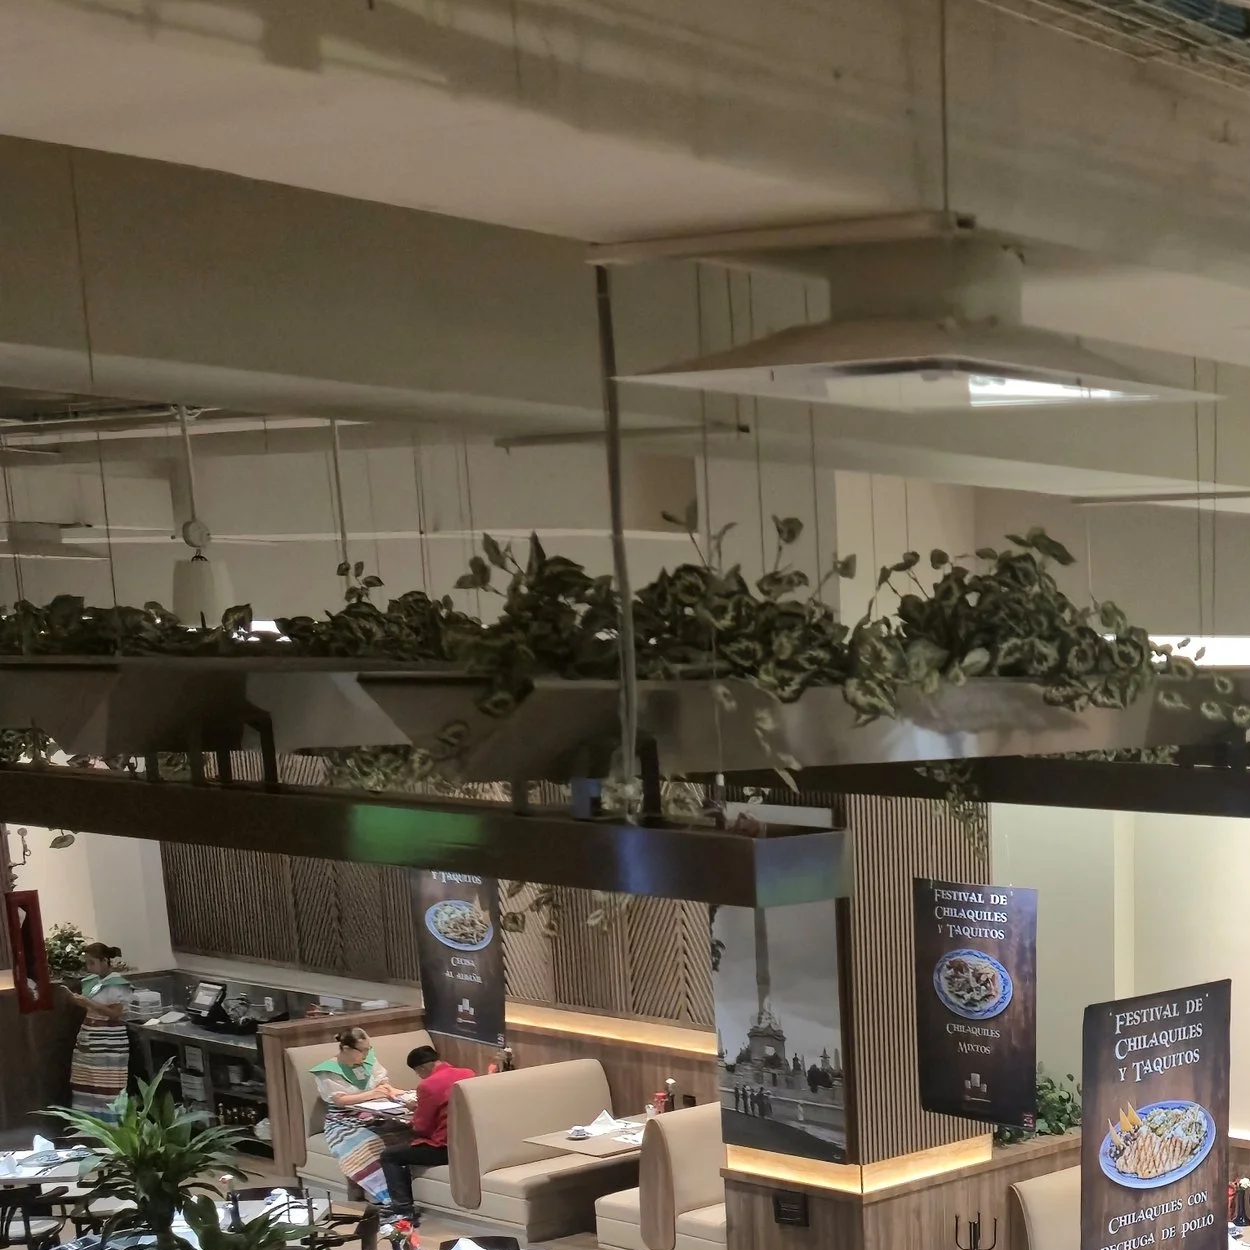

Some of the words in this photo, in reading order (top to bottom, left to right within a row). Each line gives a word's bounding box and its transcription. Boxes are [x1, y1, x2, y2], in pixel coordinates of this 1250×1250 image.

[934, 888, 984, 904] FESTIVAL
[990, 893, 1008, 906] DE
[934, 905, 1008, 923] CHILAQUILES
[937, 924, 943, 935] Y
[947, 923, 1005, 940] TAQUITOS
[1115, 1003, 1180, 1034] FESTIVAL
[1186, 998, 1203, 1014] DE
[946, 1022, 1001, 1039] CHILAQUILES
[1115, 1023, 1203, 1060] CHILAQUILES
[957, 1042, 991, 1055] MIXTOS
[1118, 1068, 1127, 1082] Y
[1132, 1049, 1200, 1082] TAQUITOS
[1108, 1200, 1183, 1235] CHILAQUILES
[1187, 1190, 1209, 1207] CON
[1161, 1225, 1177, 1241] DE
[1180, 1213, 1215, 1240] POLLO
